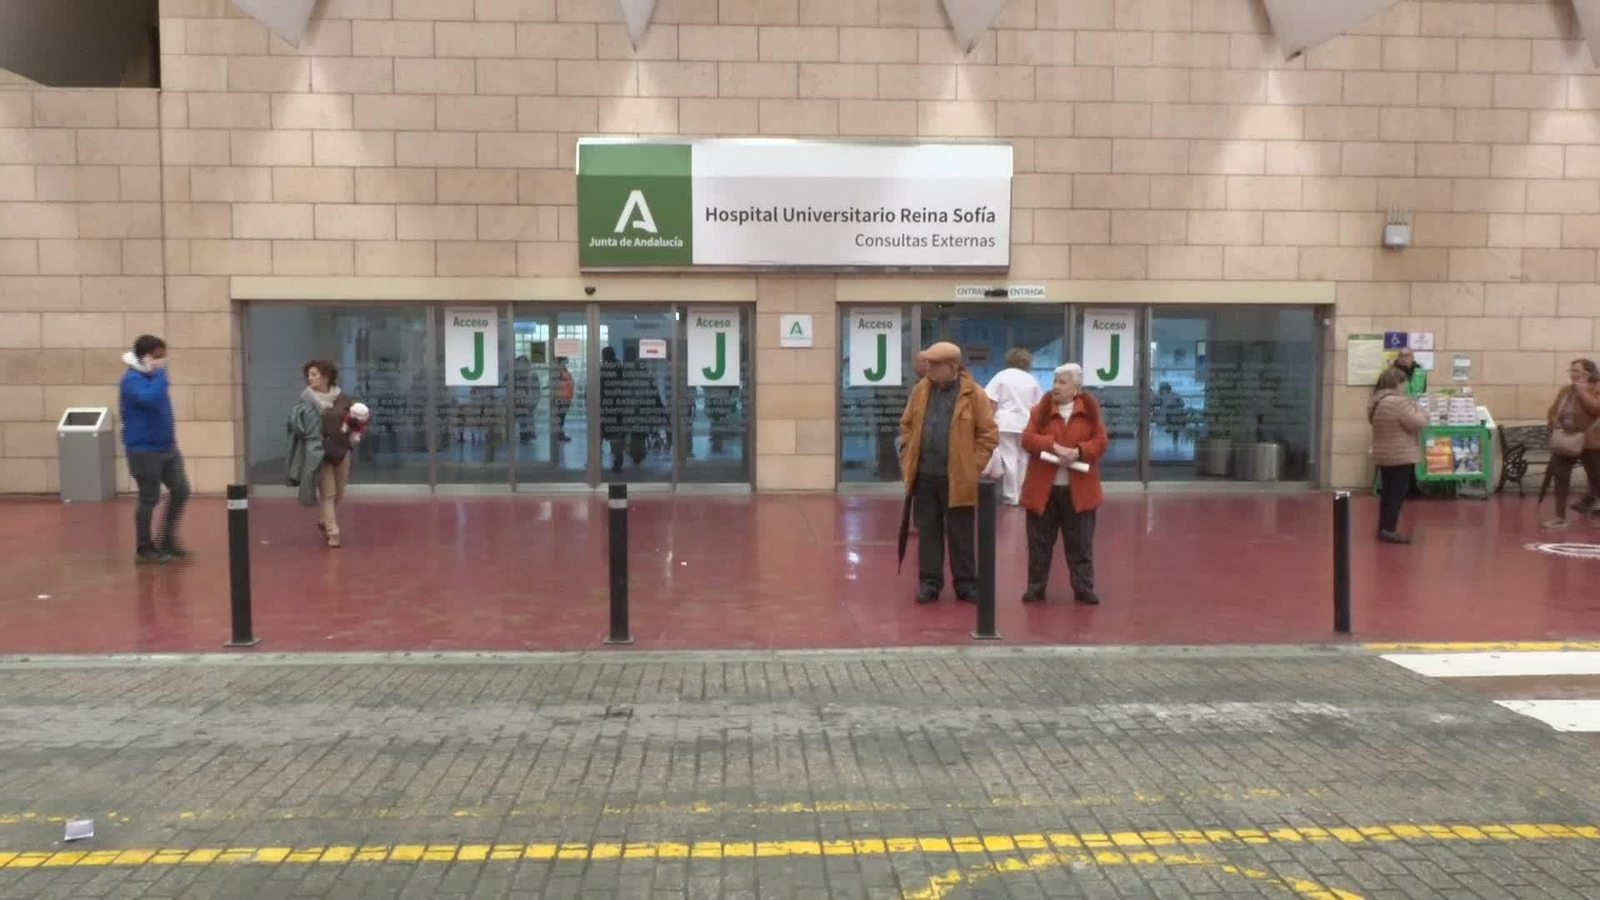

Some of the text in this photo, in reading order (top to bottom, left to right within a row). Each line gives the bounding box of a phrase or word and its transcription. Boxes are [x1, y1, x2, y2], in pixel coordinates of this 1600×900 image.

[706, 206, 996, 225] Hospital Universitario Reina Sofía
[589, 236, 683, 248] Junta de Andalucía
[855, 233, 995, 248] Consultas Externas
[1010, 286, 1044, 296] ENTRADA
[453, 316, 488, 327] Acceso
[696, 316, 731, 328] Acceso
[858, 317, 893, 329] Acceso
[1093, 319, 1126, 330] Acceso
[460, 332, 485, 380] J
[702, 332, 726, 380] J
[863, 334, 887, 382] J
[1096, 334, 1120, 381] J
